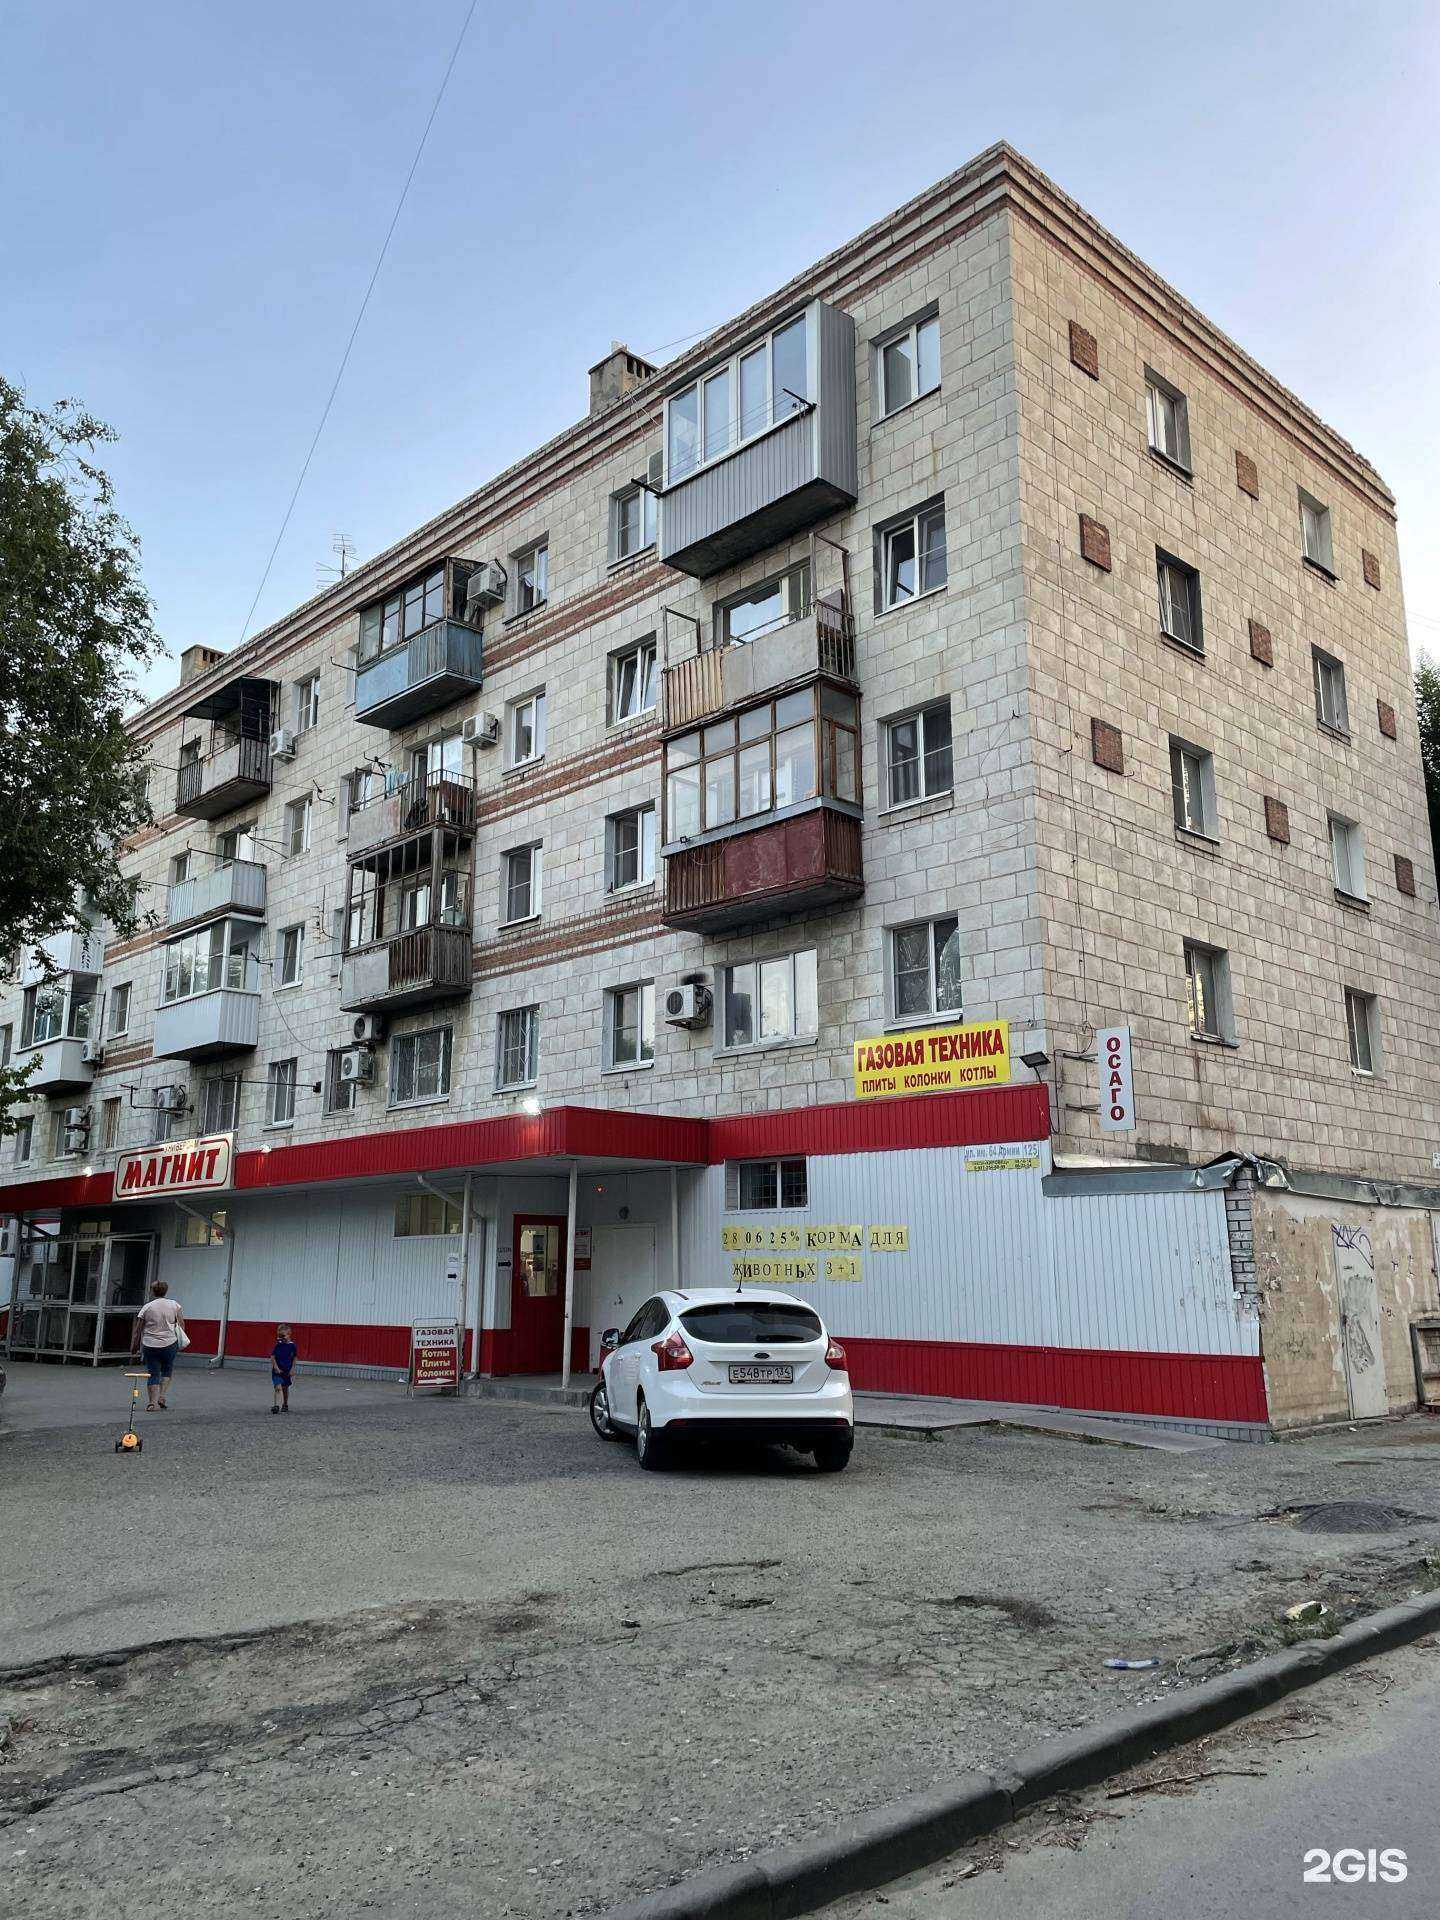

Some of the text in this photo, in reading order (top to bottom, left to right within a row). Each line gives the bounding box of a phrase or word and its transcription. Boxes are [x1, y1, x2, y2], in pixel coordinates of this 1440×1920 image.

[857, 1028, 1005, 1072] ГАЗОВАЯ ТЕХНИКА
[862, 1064, 997, 1093] ПЛИТЫ КОЛОНКИ КОТЛЫ
[1106, 1036, 1125, 1122] ОСАГО
[121, 1148, 221, 1190] МАГНИТ
[807, 1231, 862, 1247] КОРМА
[870, 1231, 904, 1246] ДЛЯ
[732, 1263, 816, 1279] ЖИВОТНЫХ
[416, 1328, 454, 1336] ГАЗОВАЯ
[416, 1339, 455, 1347] ТЕХНИКА
[422, 1349, 450, 1358] Котлы
[421, 1359, 450, 1368] Плиты
[417, 1369, 455, 1378] Колонки
